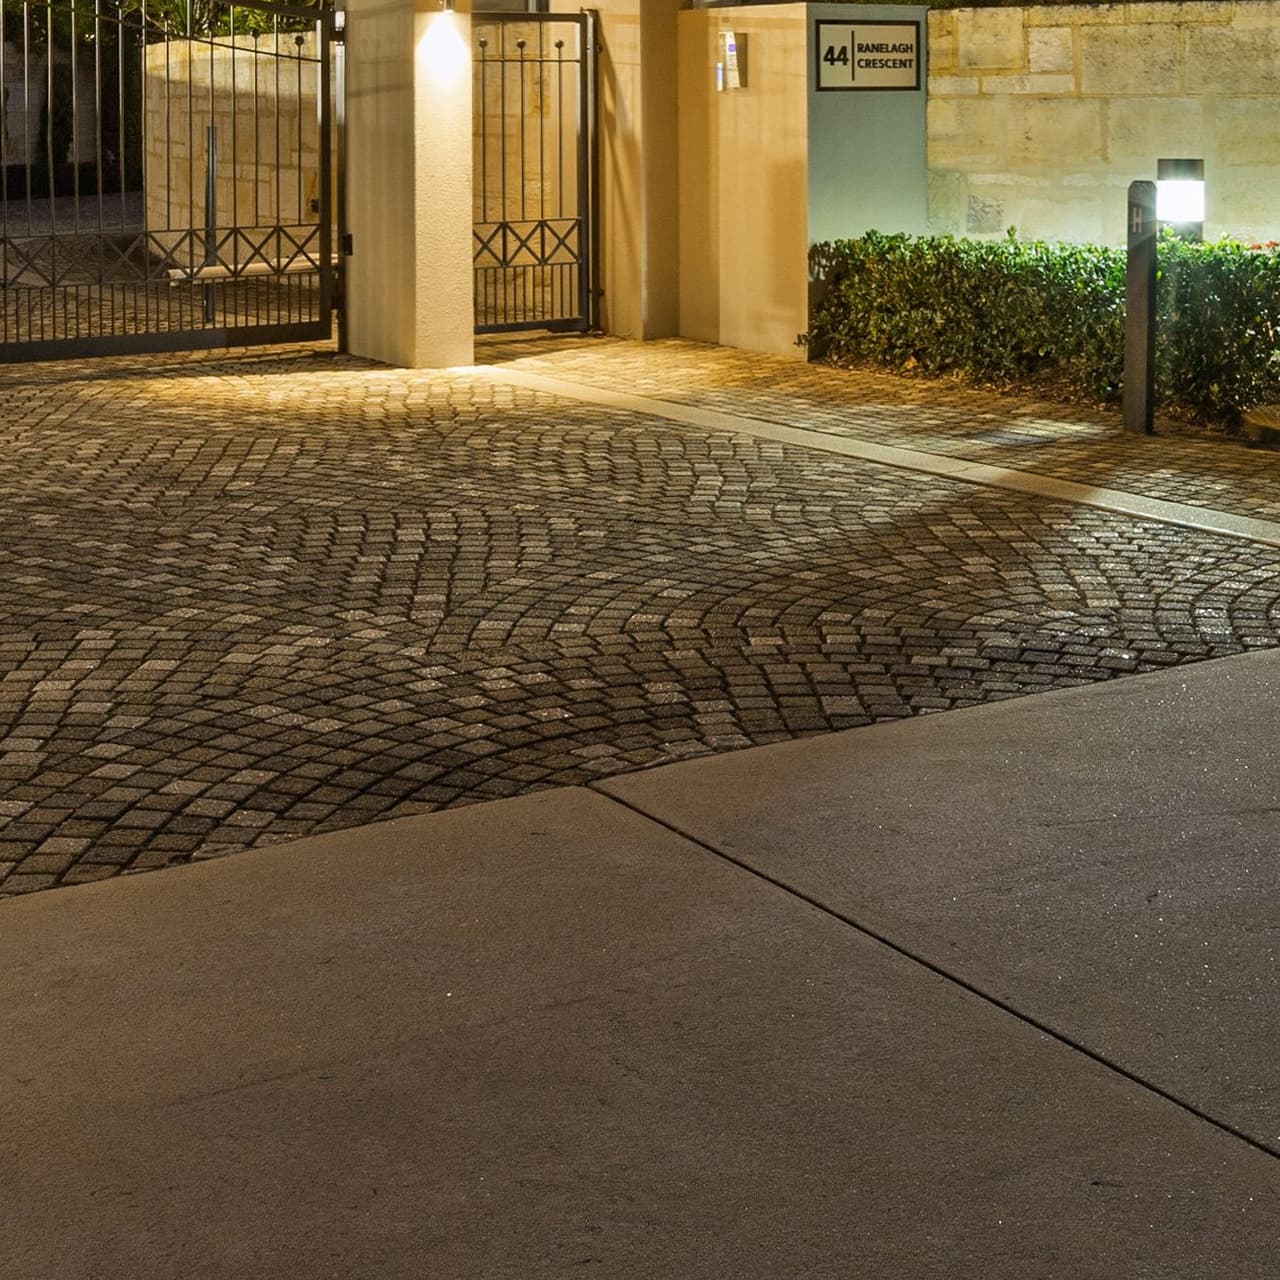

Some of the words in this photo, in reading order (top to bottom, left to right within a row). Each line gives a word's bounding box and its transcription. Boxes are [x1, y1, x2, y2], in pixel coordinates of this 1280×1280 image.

[823, 45, 849, 66] 44
[857, 43, 913, 53] RANELAGH
[857, 58, 914, 69] CRESCENT
[1132, 207, 1142, 233] H
